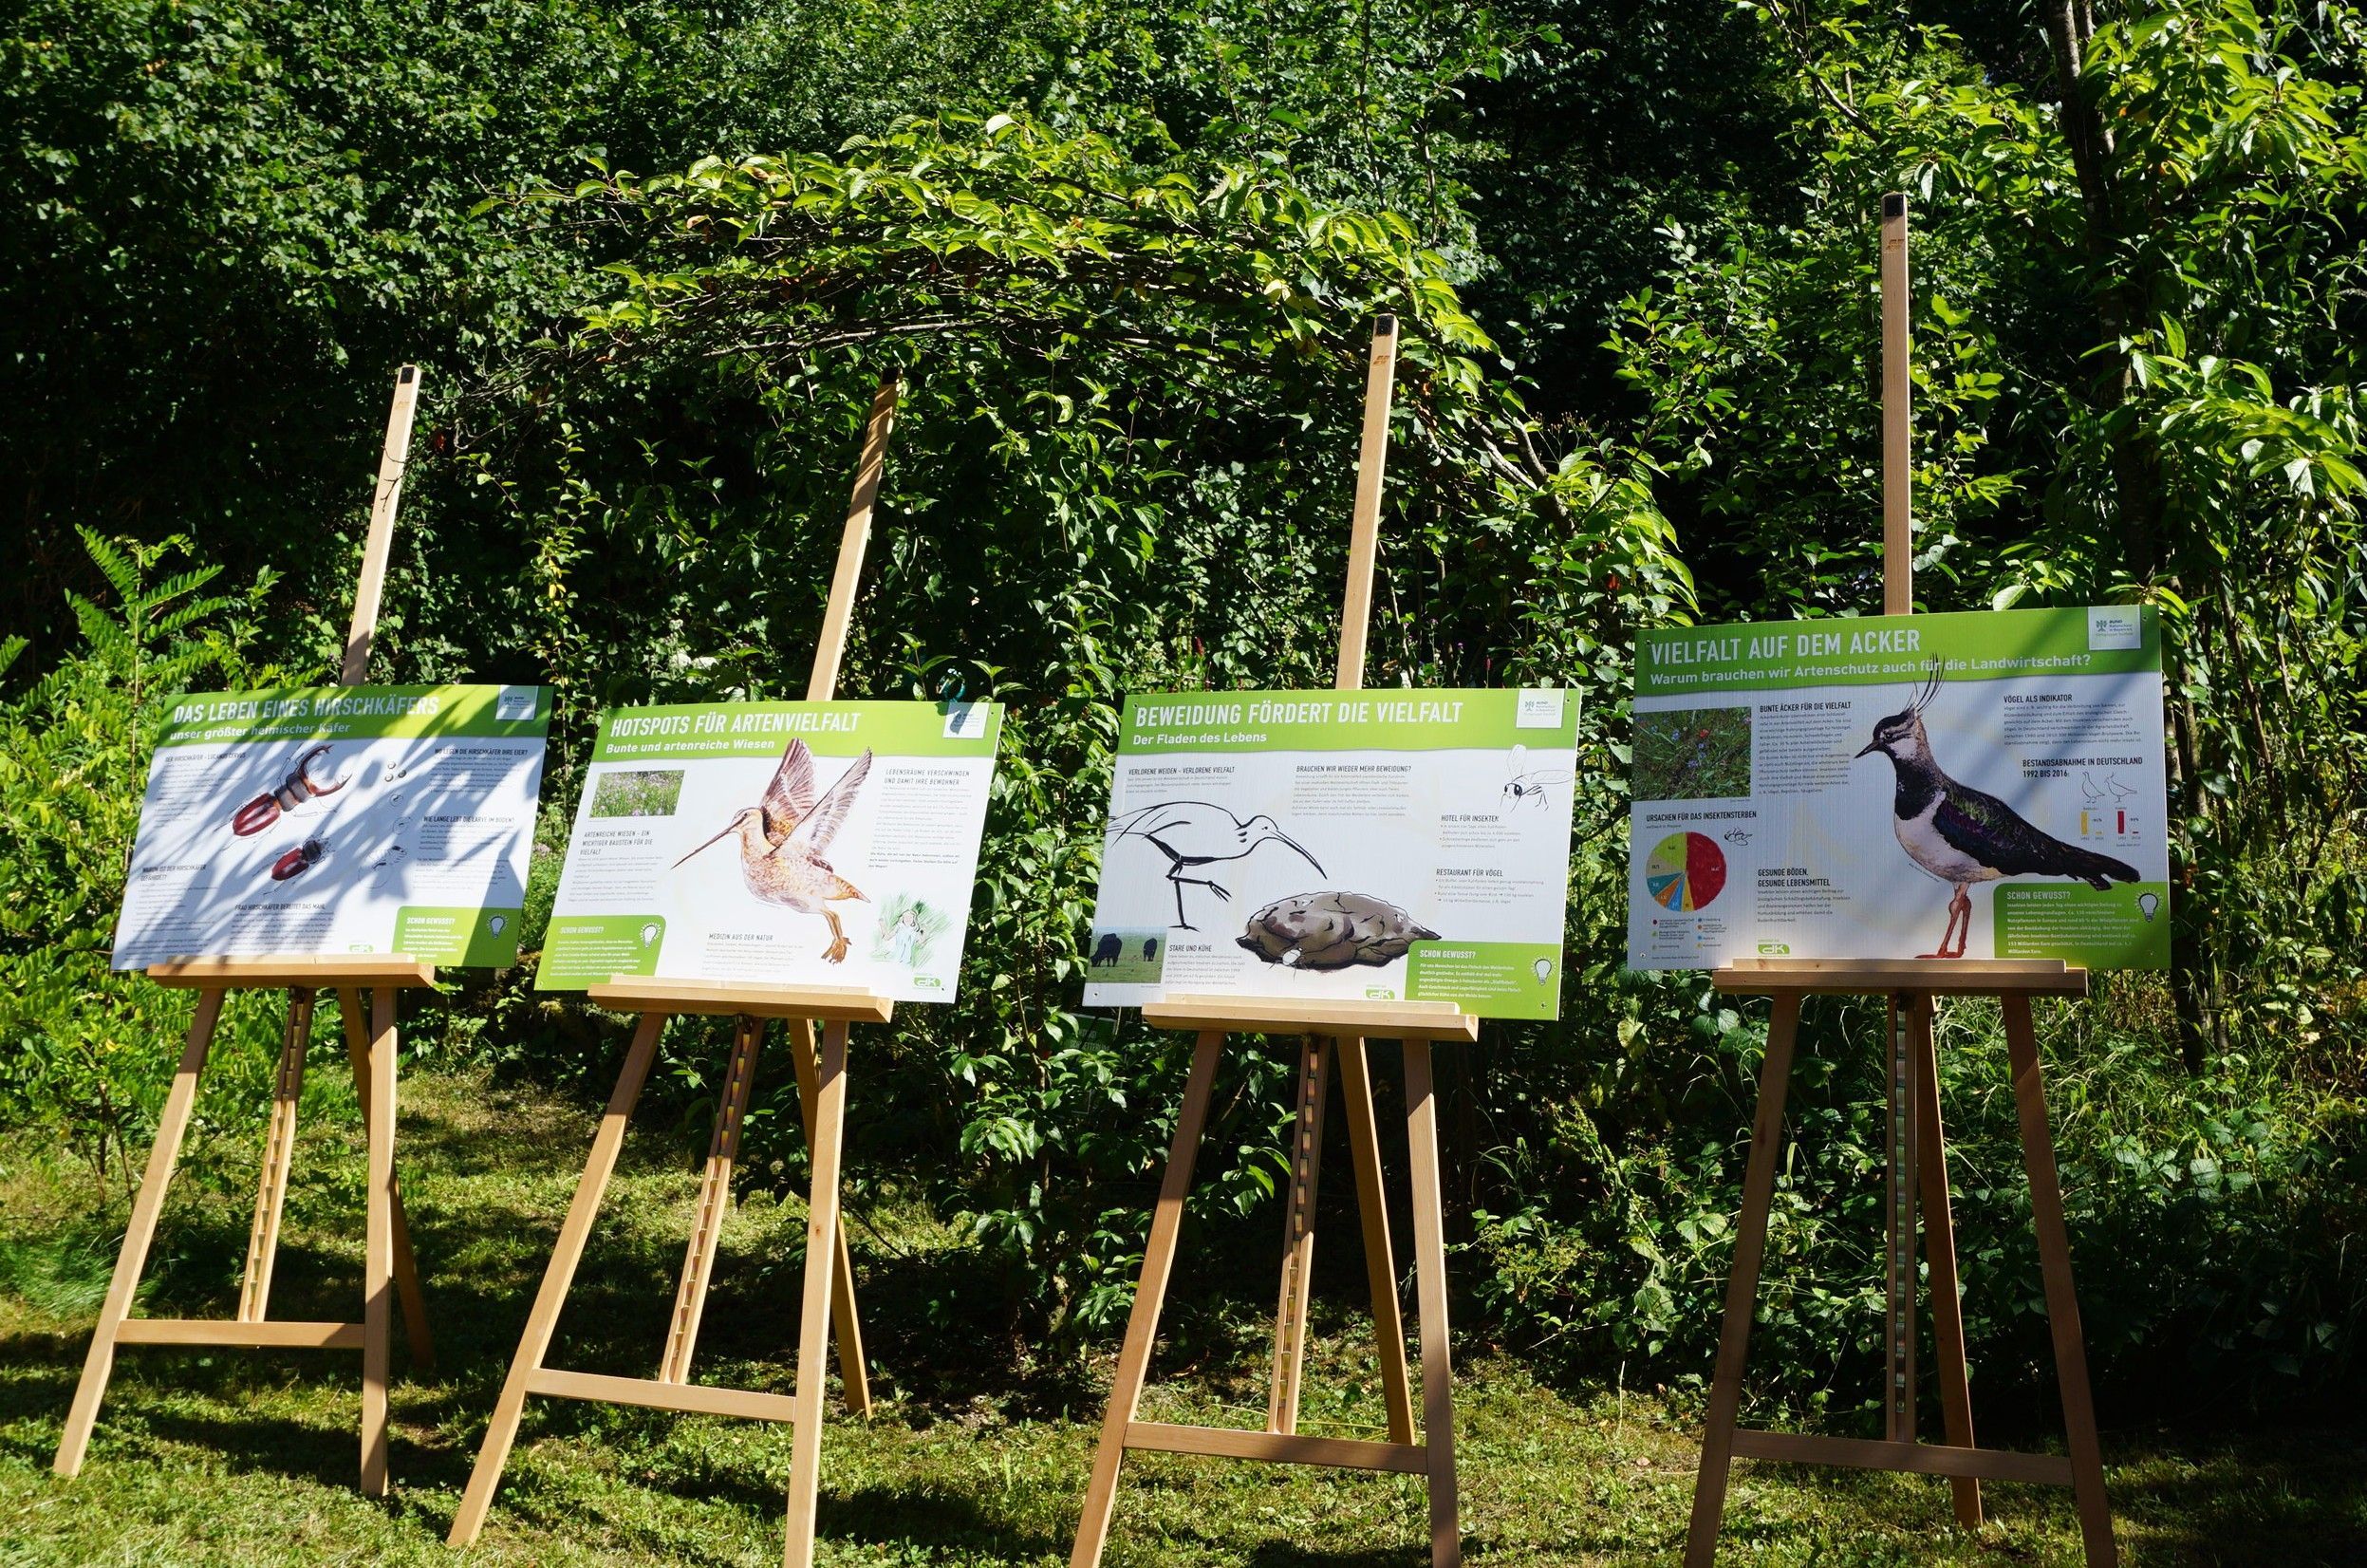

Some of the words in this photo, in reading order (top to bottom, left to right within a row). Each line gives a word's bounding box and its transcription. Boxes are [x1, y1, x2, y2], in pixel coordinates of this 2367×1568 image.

[1651, 638, 1741, 664] VIELFALT
[1748, 636, 1788, 659] AUF
[1798, 632, 1841, 657] DEM
[1849, 629, 1921, 654] ACKER
[1650, 674, 1697, 685] Warum
[1702, 668, 1763, 681] brauchen
[1769, 666, 1791, 678] wir
[1794, 664, 1879, 678] Artenschutz
[1883, 661, 1915, 674] auch
[1920, 660, 1940, 672] für
[1946, 659, 1966, 670] die
[1971, 654, 2091, 670] Landwirtschaft?
[2004, 695, 2023, 703] VÖGEL
[2040, 694, 2073, 702] INDIKATOR
[173, 704, 204, 724] DAS
[208, 700, 258, 721] LEBEN
[262, 699, 309, 719] EINES
[314, 694, 440, 717] HIRSCHKÄFERS
[1780, 702, 1799, 712] ÄCKER
[1801, 702, 1813, 711] FÜR
[1825, 701, 1851, 710] VIELFALT
[1135, 704, 1241, 727] BEWEIDUNG
[1248, 700, 1333, 724] FÖRDERT
[1338, 702, 1370, 723] DIE
[1376, 701, 1463, 723] VIELFALT
[610, 716, 691, 737] HOTSPOTS
[695, 712, 727, 735] FÜR
[731, 713, 862, 733] ARTENVIELFALT
[170, 731, 200, 740] unser
[204, 726, 248, 740] größter
[252, 724, 315, 736] heimischer
[1133, 735, 1154, 745] Der
[1157, 733, 1197, 744] Fladen
[1200, 733, 1221, 743] des
[1224, 733, 1267, 742] Lebens
[606, 743, 638, 754] Bunte
[642, 742, 661, 752] und
[664, 740, 729, 751] artenreiche
[733, 738, 774, 750] Wiesen
[2022, 758, 2086, 768] BESTANDSABNAHME
[2097, 757, 2143, 766] DEUTSCHLAND
[2023, 770, 2039, 778] 1992
[1646, 813, 1676, 822] URSACHEN
[1677, 812, 1689, 821] FÜR
[1704, 811, 1757, 820] INSEKTENSTERBEN
[1485, 868, 1503, 877] VÖGEL
[1758, 868, 1785, 877] GESUNDE
[1758, 879, 1785, 887] GESUNDE
[1786, 878, 1830, 887] LEBENSMITTEL
[2006, 891, 2031, 900] SCHON
[2033, 890, 2071, 900] GEWUSST?
[1198, 943, 1212, 952] KÜHE
[1420, 949, 1441, 959] SCHON
[1443, 950, 1476, 959] GEWUSST?
